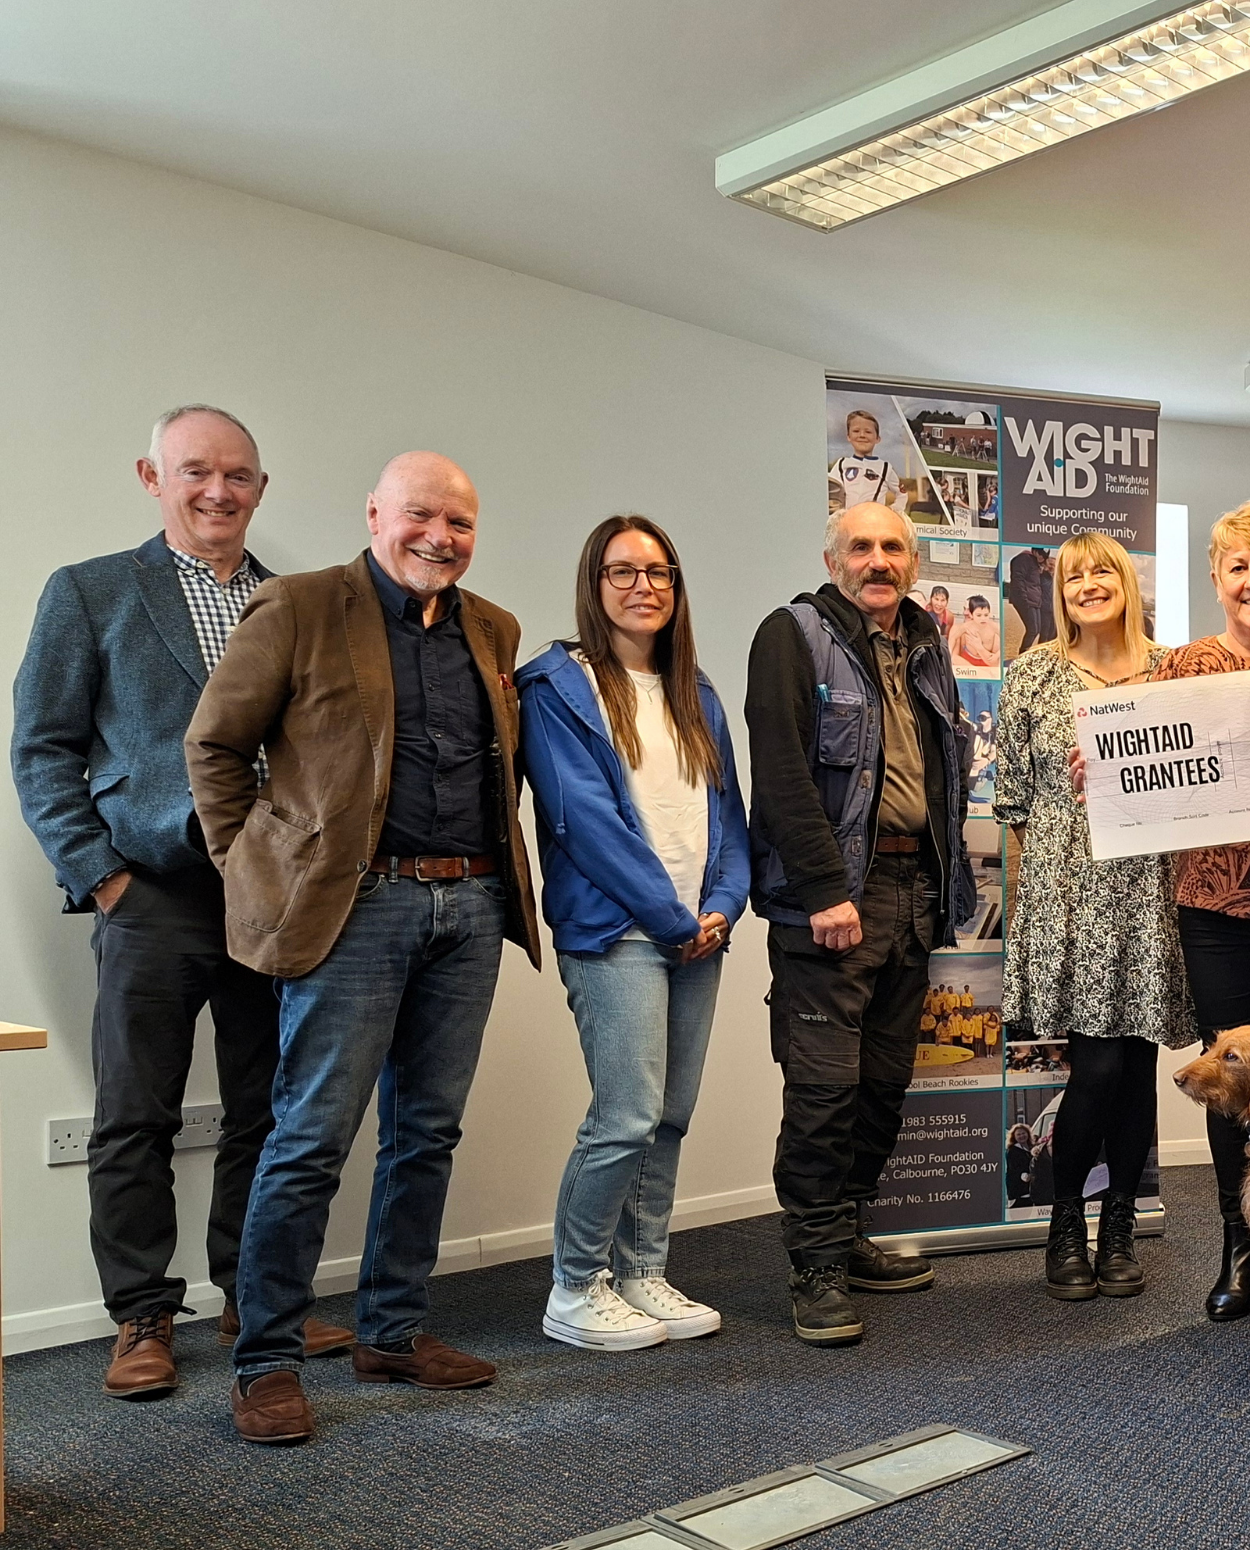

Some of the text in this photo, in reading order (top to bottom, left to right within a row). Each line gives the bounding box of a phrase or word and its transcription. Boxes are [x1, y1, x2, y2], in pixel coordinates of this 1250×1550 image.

[1004, 416, 1155, 467] WIGHT
[1022, 457, 1098, 498] AID
[1105, 474, 1149, 486] The WightAid
[1105, 482, 1149, 496] Foundation
[1040, 505, 1128, 522] Supporting our
[940, 526, 967, 538] Society
[1027, 521, 1137, 541] unique Community
[955, 667, 977, 676] Swim
[1090, 701, 1136, 716] NatWest
[1095, 722, 1194, 760] WIGHTAID
[1120, 756, 1220, 794] GRANTEES
[923, 1080, 946, 1089] Beach
[949, 1078, 979, 1087] Rookies
[929, 1114, 967, 1126] 555915
[929, 1151, 984, 1163] Foundation
[893, 1168, 948, 1180] Calbourne,
[951, 1164, 978, 1175] PO30
[980, 1162, 998, 1173] 4JY
[907, 1194, 924, 1204] No.
[927, 1189, 971, 1203] 1166476
